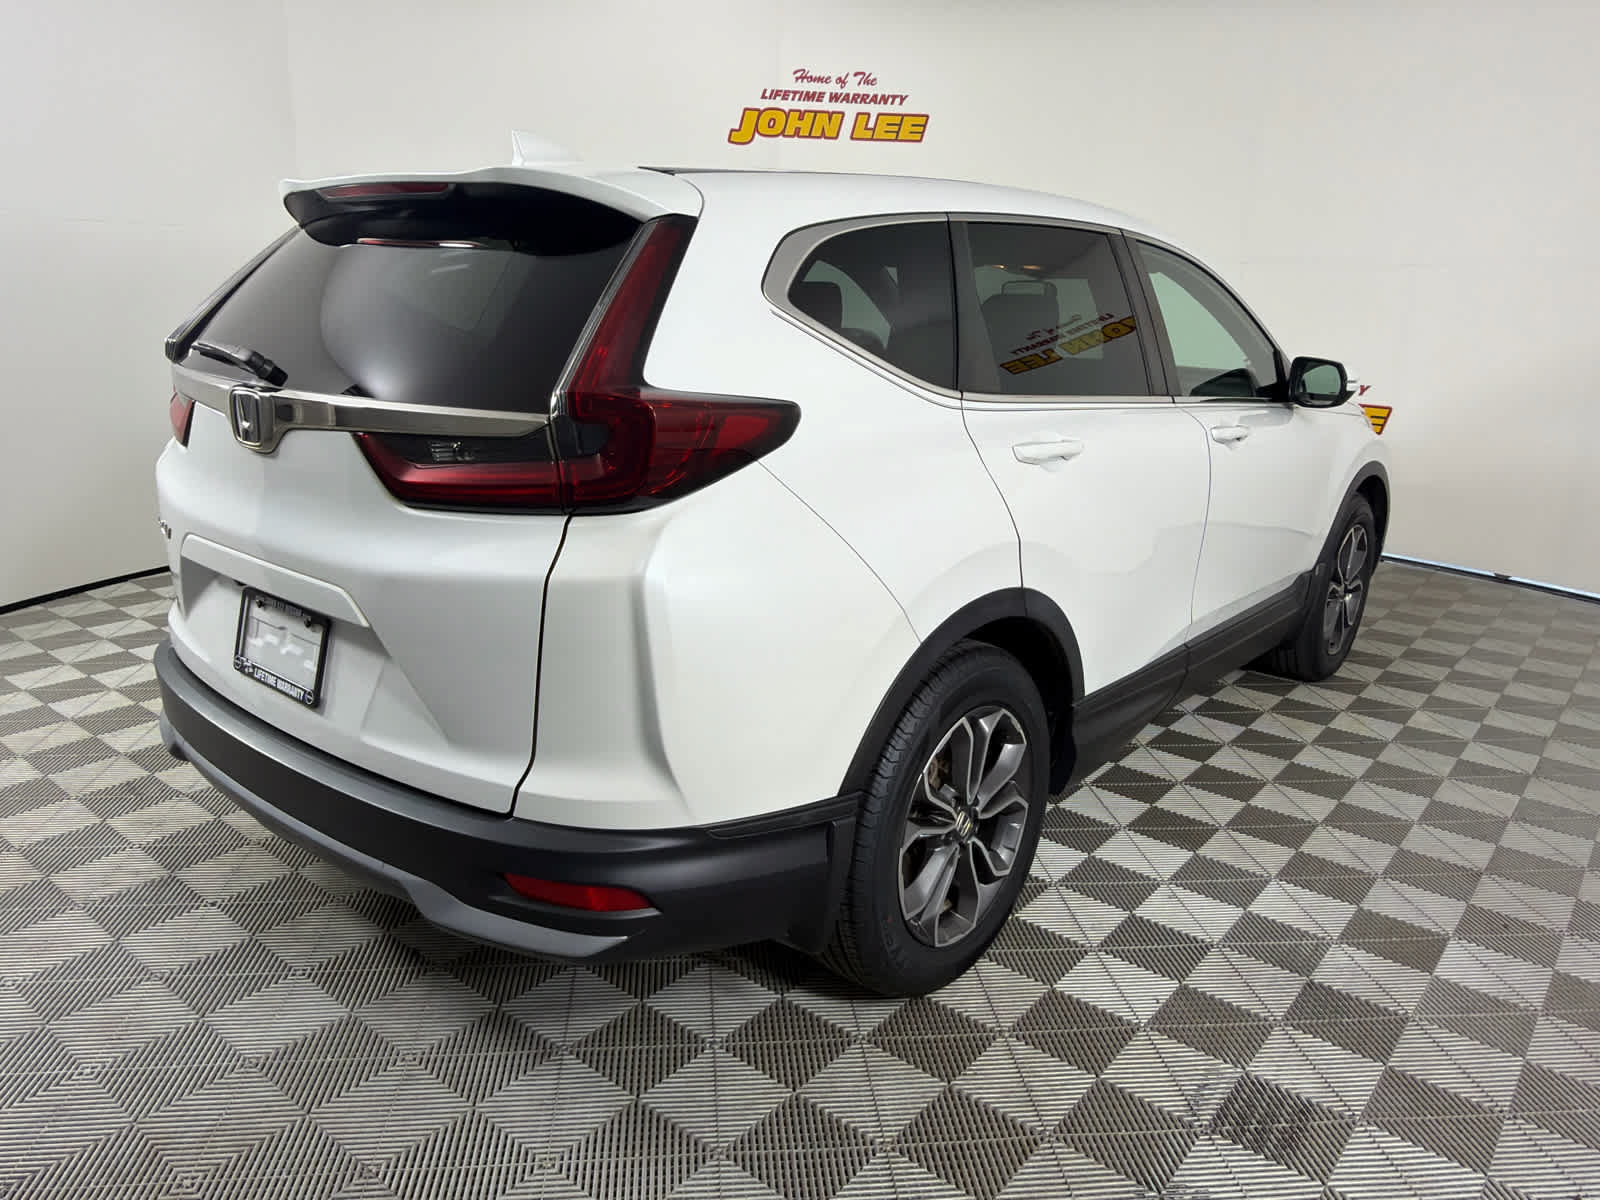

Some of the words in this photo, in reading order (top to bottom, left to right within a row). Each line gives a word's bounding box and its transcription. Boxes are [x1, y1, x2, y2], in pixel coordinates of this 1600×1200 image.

[792, 68, 832, 85] Home
[835, 72, 850, 89] of
[853, 71, 878, 87] The
[760, 88, 825, 104] LIFETIME
[828, 91, 909, 106] WARRANTY
[727, 107, 845, 146] JOHN
[850, 112, 929, 143] LEE
